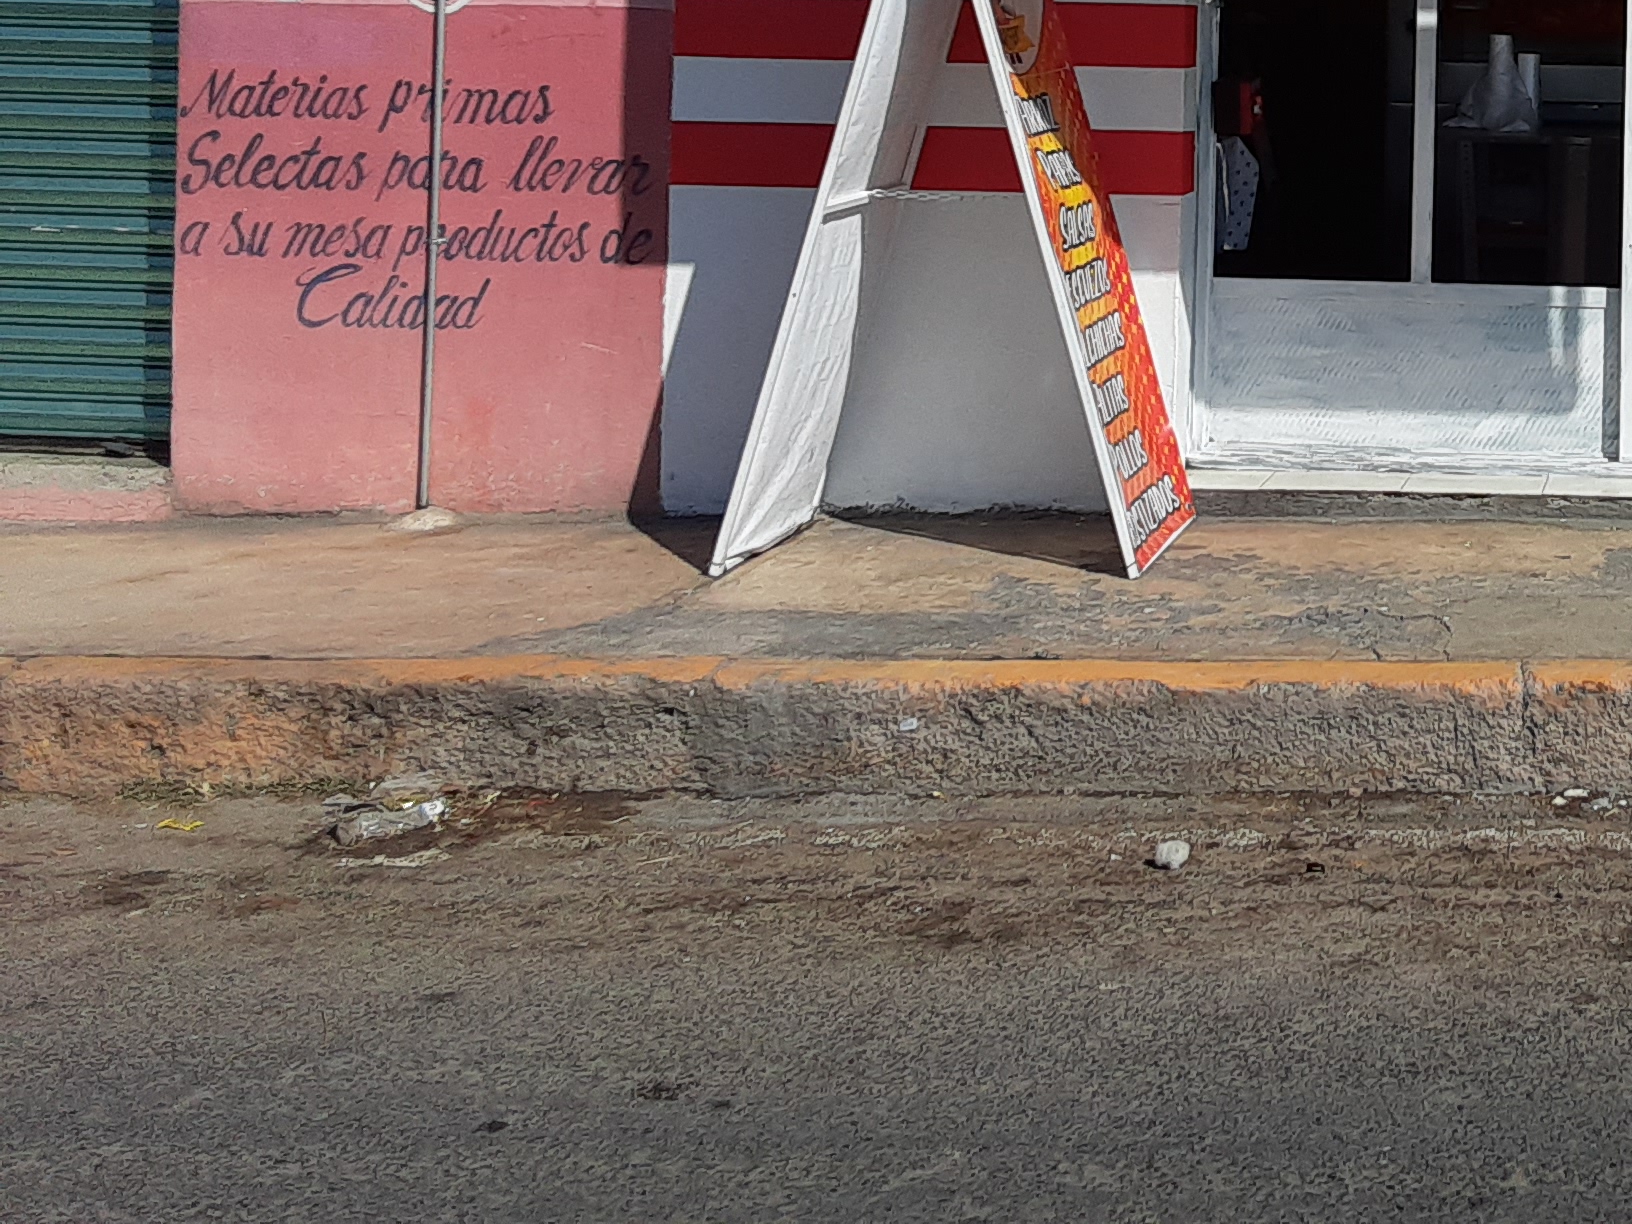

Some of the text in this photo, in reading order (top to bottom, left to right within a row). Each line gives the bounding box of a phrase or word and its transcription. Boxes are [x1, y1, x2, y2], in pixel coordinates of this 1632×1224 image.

[180, 69, 555, 132] Materias primas
[180, 130, 651, 201] Selectas para llevar
[179, 219, 210, 258] a
[282, 214, 393, 260] mesa
[600, 211, 654, 266] de
[1059, 200, 1097, 251] SALSAS
[296, 264, 492, 329] Calidad
